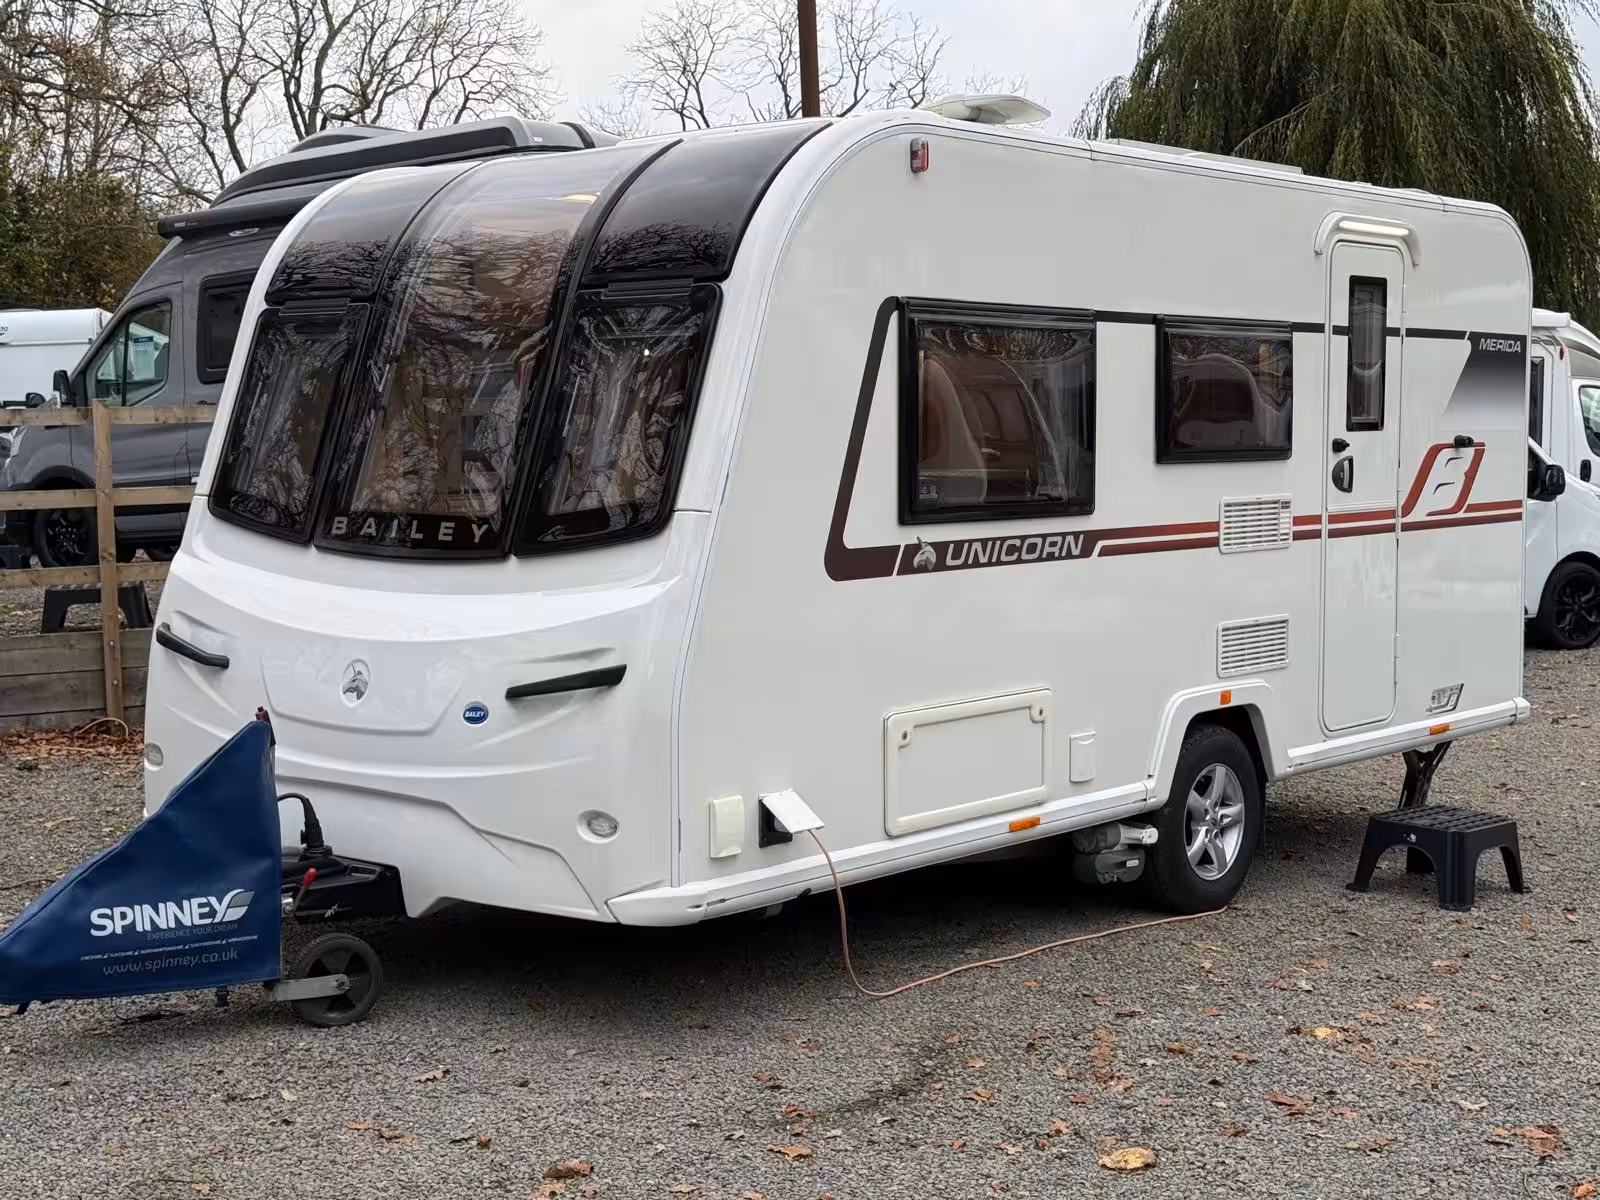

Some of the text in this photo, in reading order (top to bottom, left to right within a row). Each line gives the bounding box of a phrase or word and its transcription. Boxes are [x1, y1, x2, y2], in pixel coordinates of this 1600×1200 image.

[1479, 338, 1521, 352] MERIDA
[331, 516, 490, 543] BAILEY
[945, 534, 1085, 567] UNICORN
[464, 710, 485, 718] BAILEY
[90, 889, 248, 937] SPINNEY
[193, 926, 213, 936] YOUR
[103, 948, 238, 975] www.spinney.co.uk
